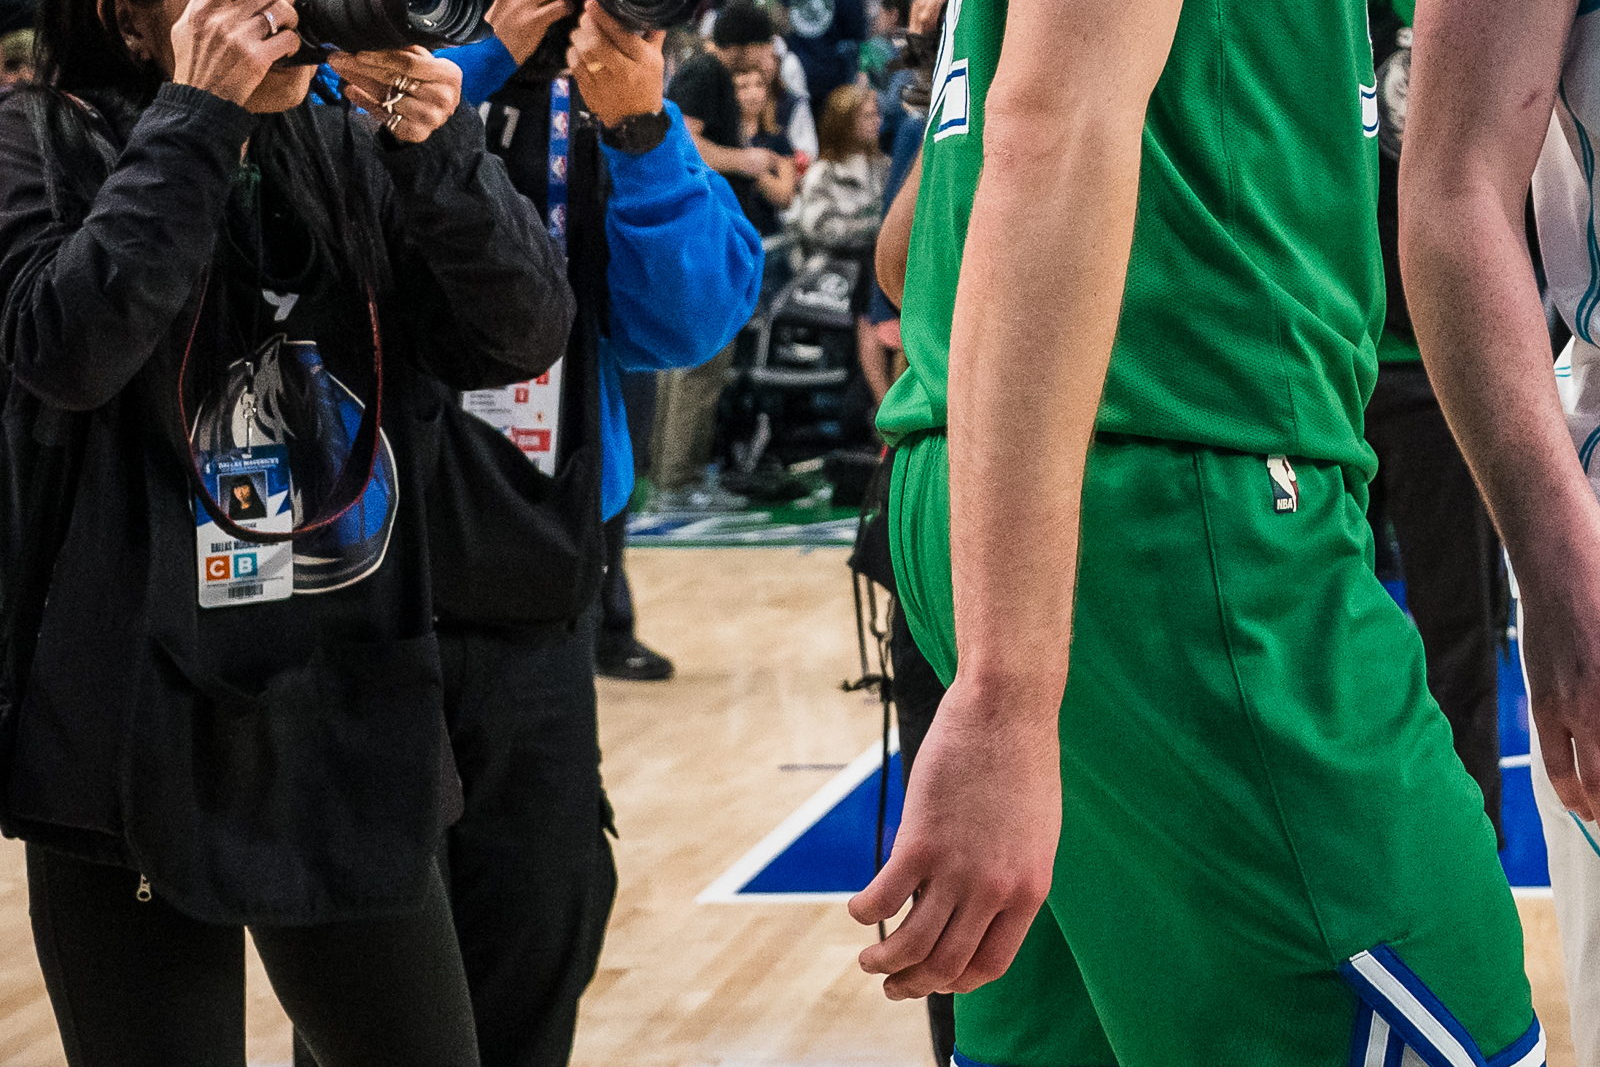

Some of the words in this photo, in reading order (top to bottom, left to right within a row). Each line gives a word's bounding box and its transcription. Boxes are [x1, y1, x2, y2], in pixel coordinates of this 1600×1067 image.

[1276, 497, 1293, 510] NBA
[209, 559, 226, 577] C
[237, 556, 253, 574] B
